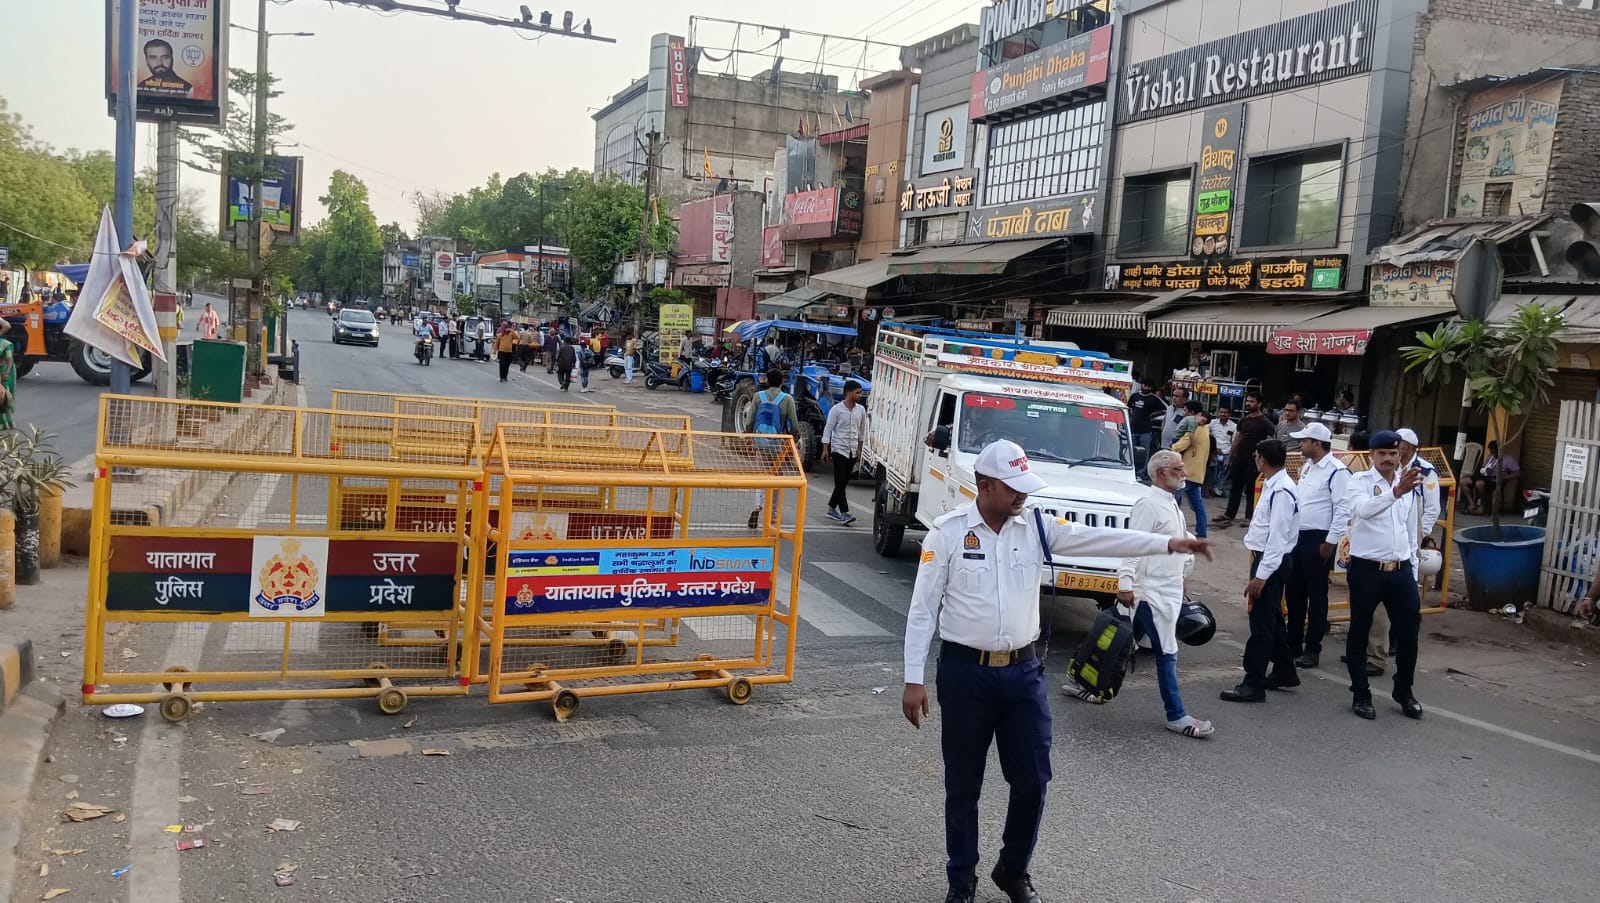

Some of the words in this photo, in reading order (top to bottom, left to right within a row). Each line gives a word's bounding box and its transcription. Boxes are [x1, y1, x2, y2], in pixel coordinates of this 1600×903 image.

[673, 50, 684, 105] HOTEL
[1002, 59, 1045, 91] Punjabi
[1046, 50, 1087, 76] Dhaba
[1125, 61, 1196, 115] Vishal
[1203, 21, 1367, 98] Restaurant
[154, 106, 174, 115] aab
[1201, 144, 1236, 176] विशाल
[900, 183, 914, 212] श्री
[916, 176, 951, 210] दाऊजी
[987, 207, 1032, 238] पंजाबी
[1034, 208, 1072, 233] ढाबा
[1124, 264, 1142, 277] शाही
[1143, 264, 1163, 276] पनीर
[1167, 263, 1203, 276] डोसा
[1260, 258, 1308, 274] चाऊमीन
[1143, 277, 1162, 288] पनीर
[1165, 279, 1200, 289] पास्ता
[1260, 274, 1307, 289] इडली
[1274, 334, 1293, 350] शुद्ध
[1296, 332, 1318, 352] देशी
[1321, 332, 1356, 350] भोजन
[146, 552, 216, 570] यातायात
[373, 552, 419, 573] उत्तर
[155, 576, 204, 605] पुलिस
[369, 578, 415, 605] प्रदेश
[545, 583, 616, 600] यातायात
[619, 578, 672, 606] पुलिस,
[677, 581, 718, 597] उत्तर
[720, 577, 756, 597] प्रदेश
[1063, 573, 1076, 586] UP
[1078, 577, 1090, 588] 83
